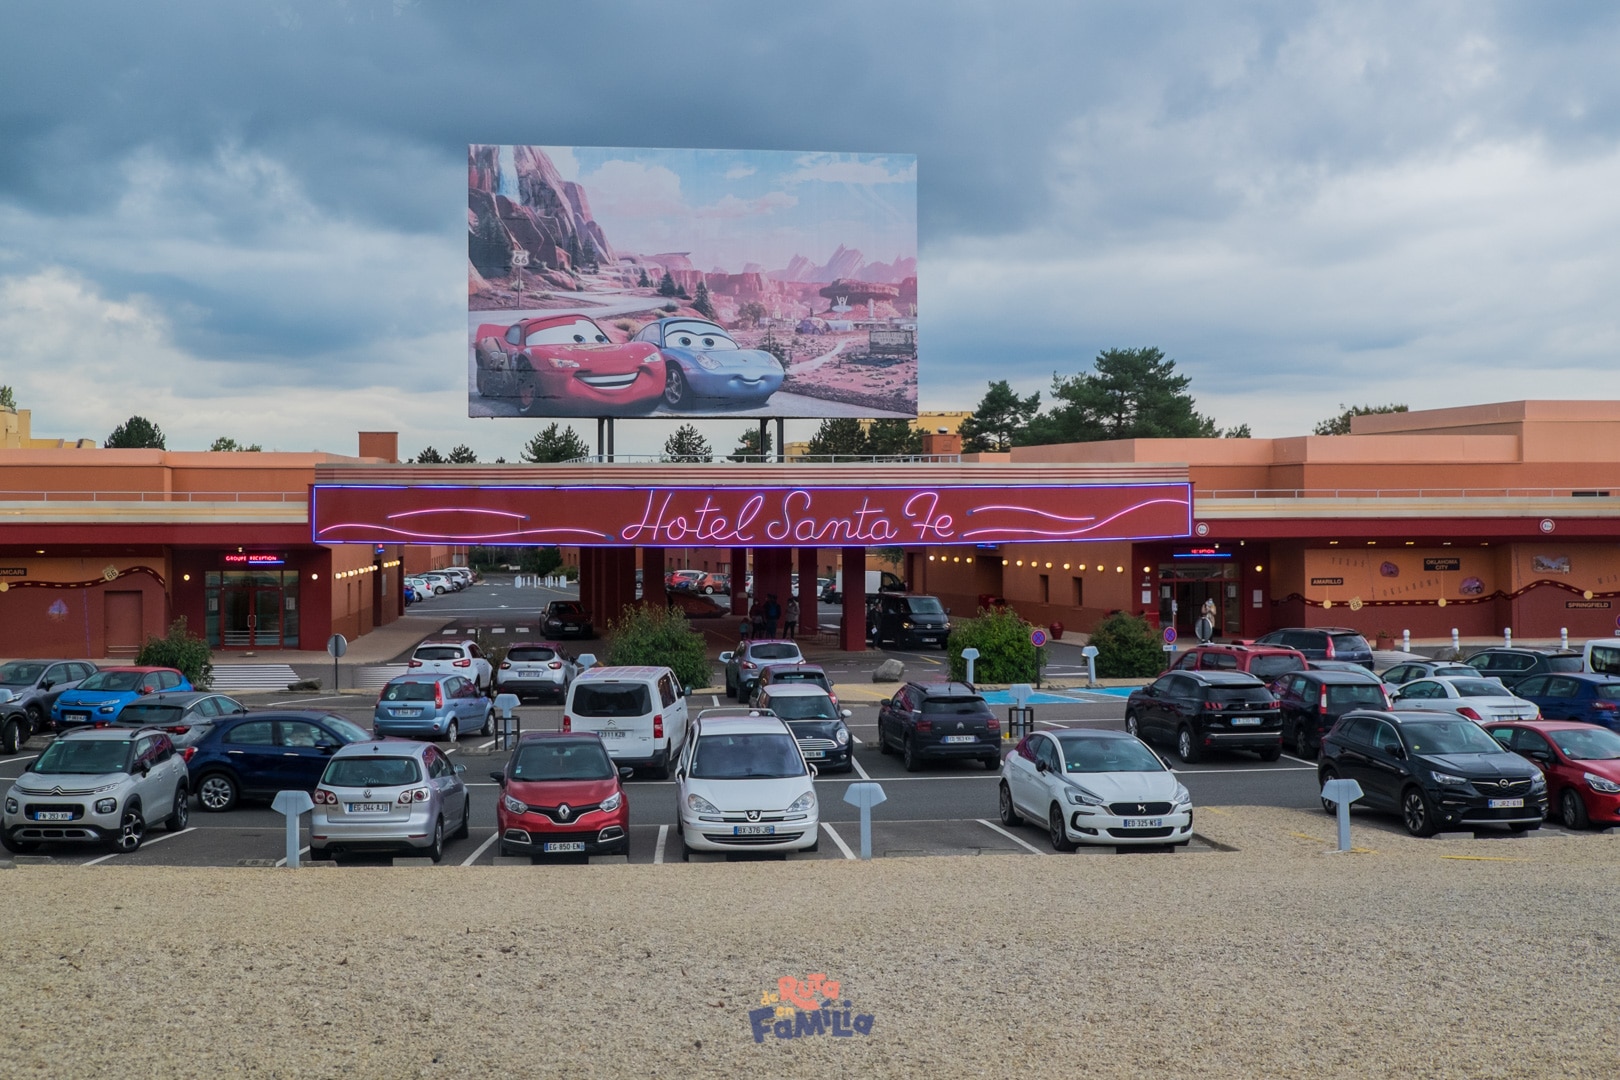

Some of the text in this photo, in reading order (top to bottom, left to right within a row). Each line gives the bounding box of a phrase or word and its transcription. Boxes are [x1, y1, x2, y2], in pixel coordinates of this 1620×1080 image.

[514, 255, 527, 264] 66
[621, 489, 955, 541] Hotel Santa Fe
